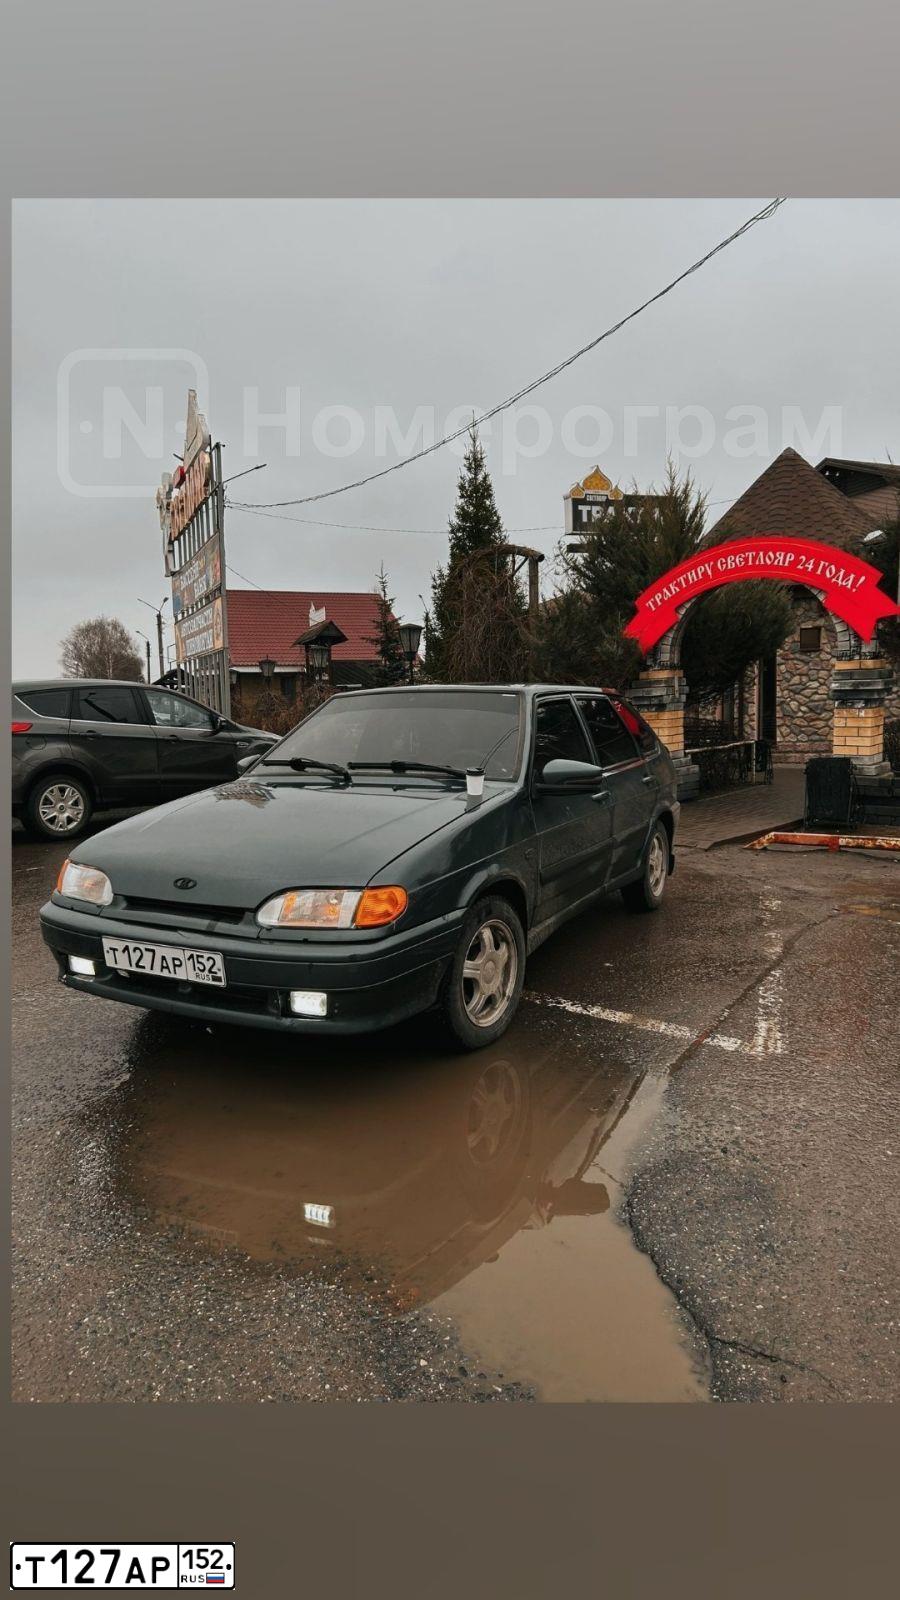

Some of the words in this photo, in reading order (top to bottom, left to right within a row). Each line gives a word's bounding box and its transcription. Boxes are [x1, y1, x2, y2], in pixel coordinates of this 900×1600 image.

[645, 561, 714, 612] ТРАКТИРУ
[716, 550, 796, 572] СВЕТЛОЯР
[796, 555, 816, 573] 24
[815, 560, 867, 593] ГОДА!
[108, 944, 183, 975] Т127АР
[186, 953, 218, 975] 152
[195, 972, 211, 981] RUS
